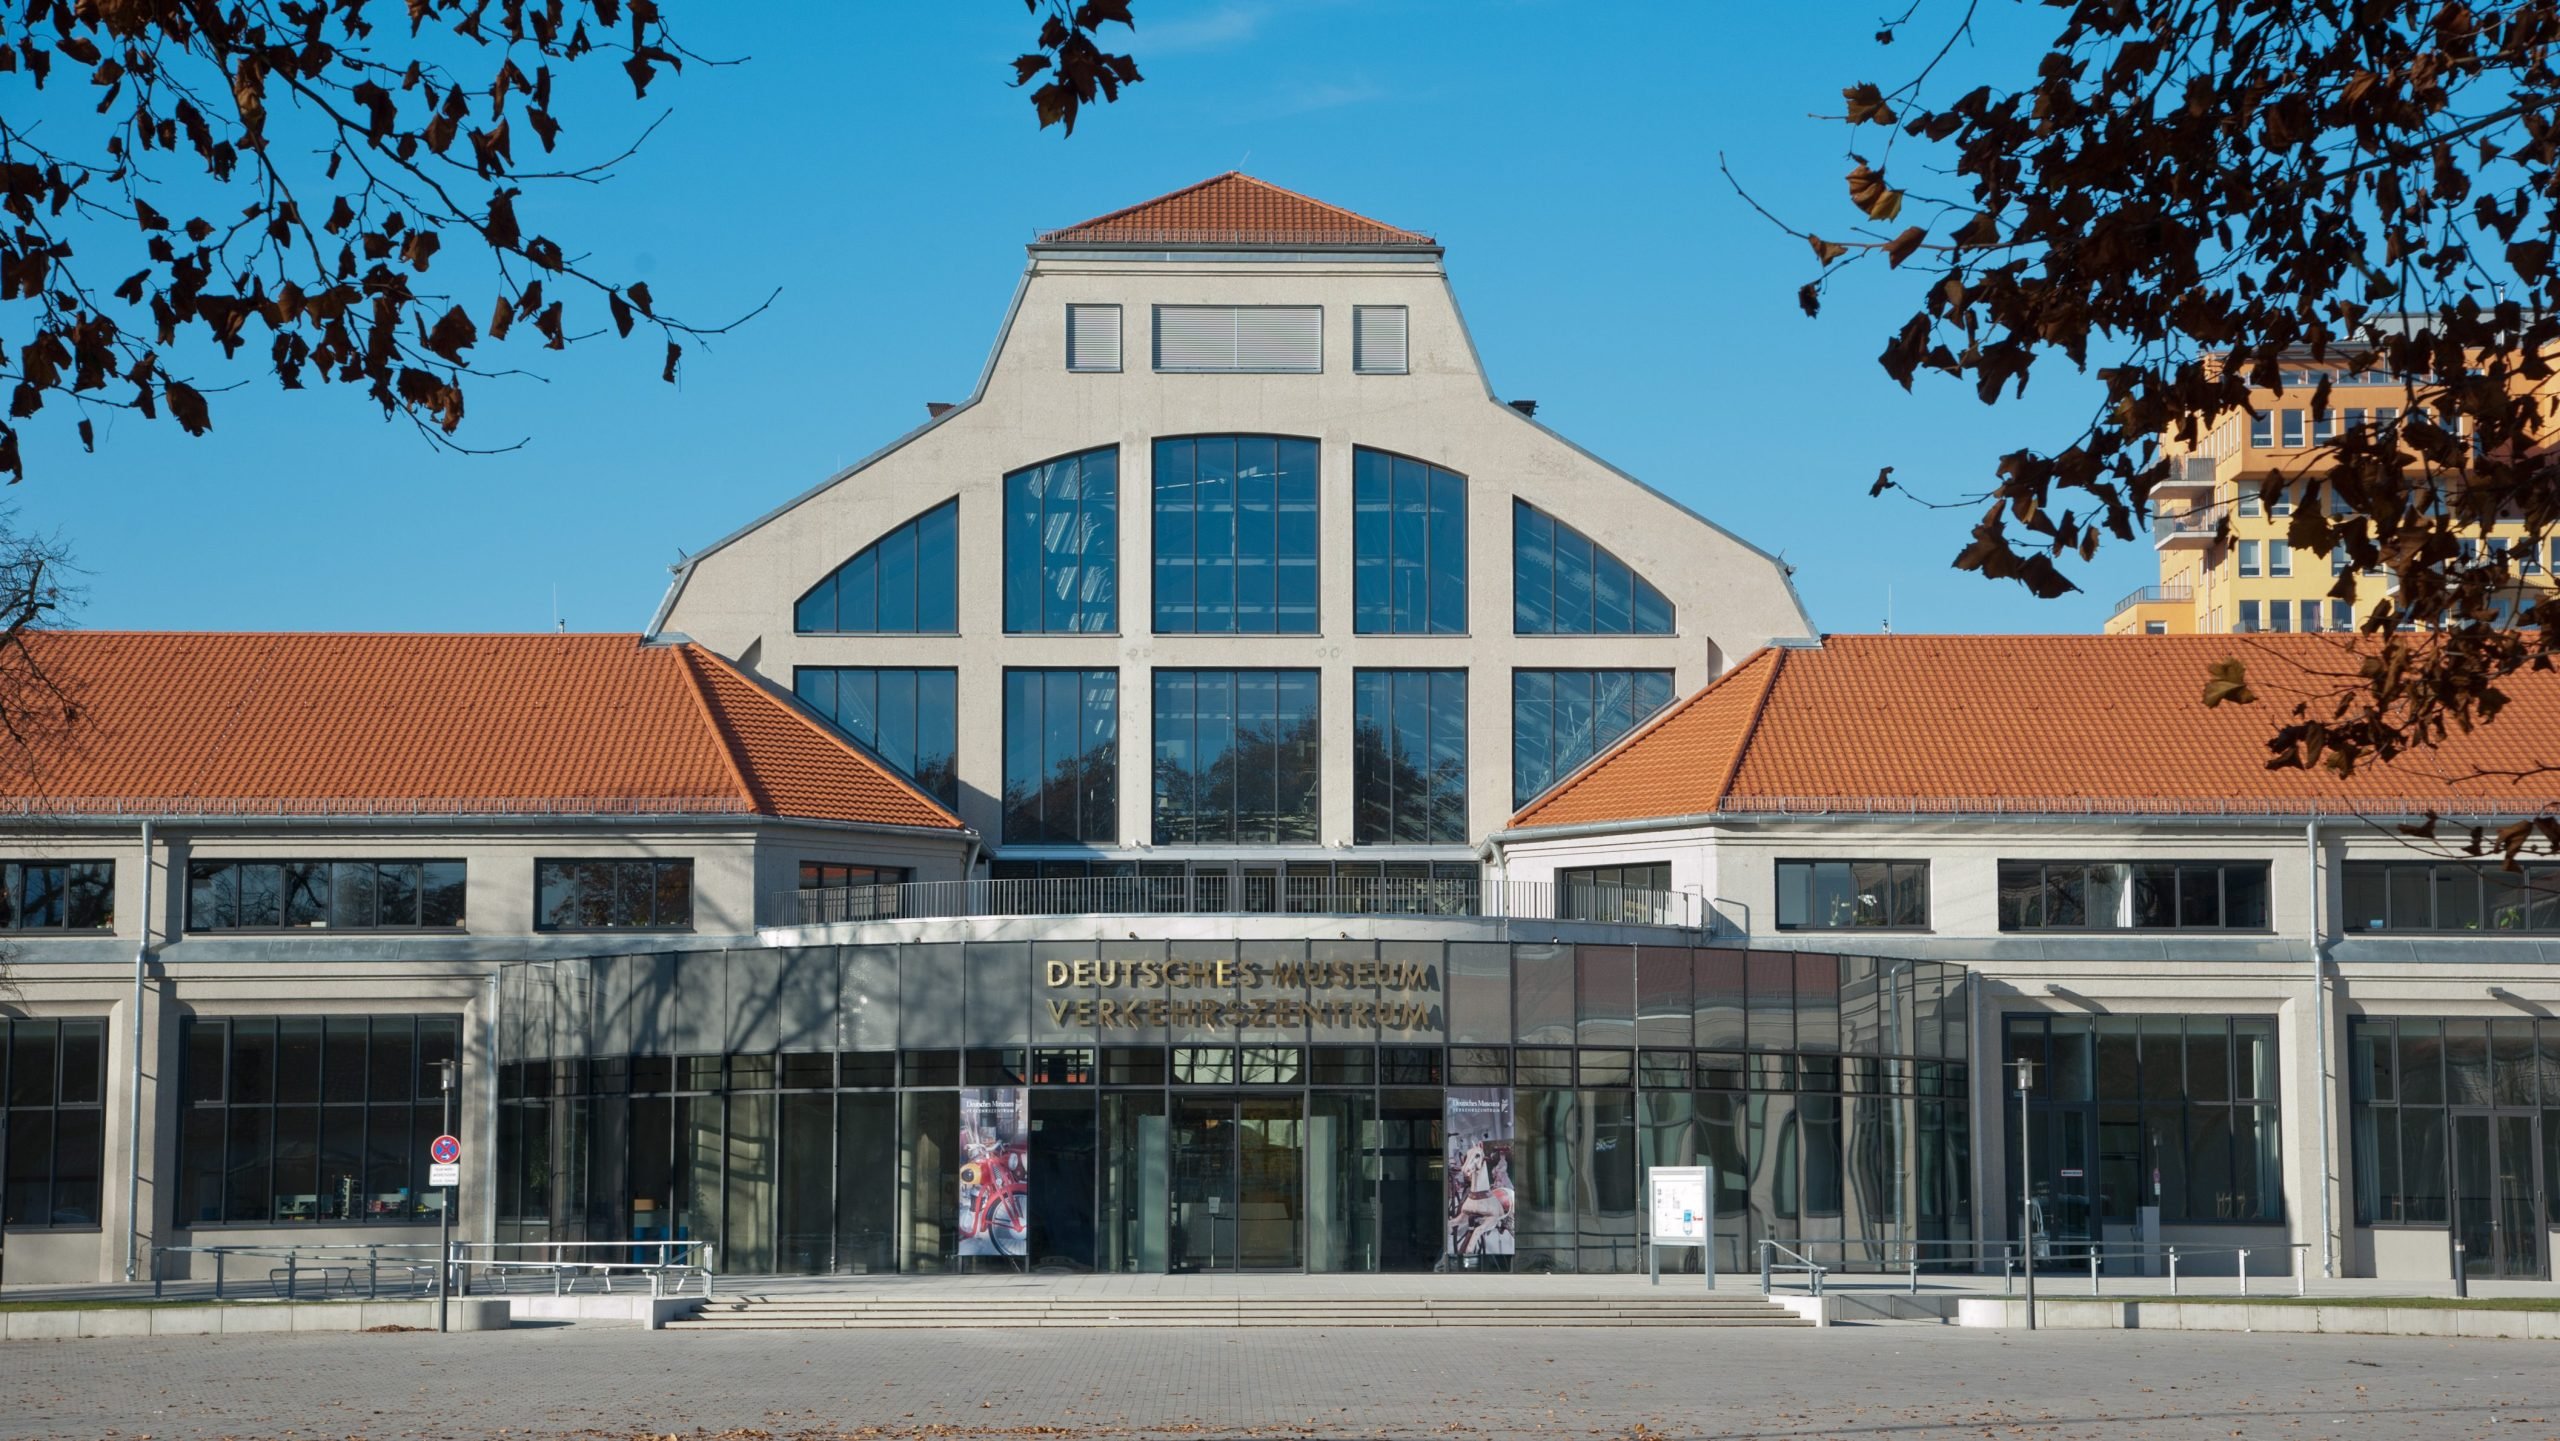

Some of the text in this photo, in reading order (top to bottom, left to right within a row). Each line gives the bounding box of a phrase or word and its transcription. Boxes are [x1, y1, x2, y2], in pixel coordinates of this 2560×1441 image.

[1046, 959, 1428, 987] DEUTSCHES MUSEUM
[1046, 999, 1430, 1027] VERKEHRSZENTRUM
[1452, 1099, 1500, 1107] Deutsches Museum
